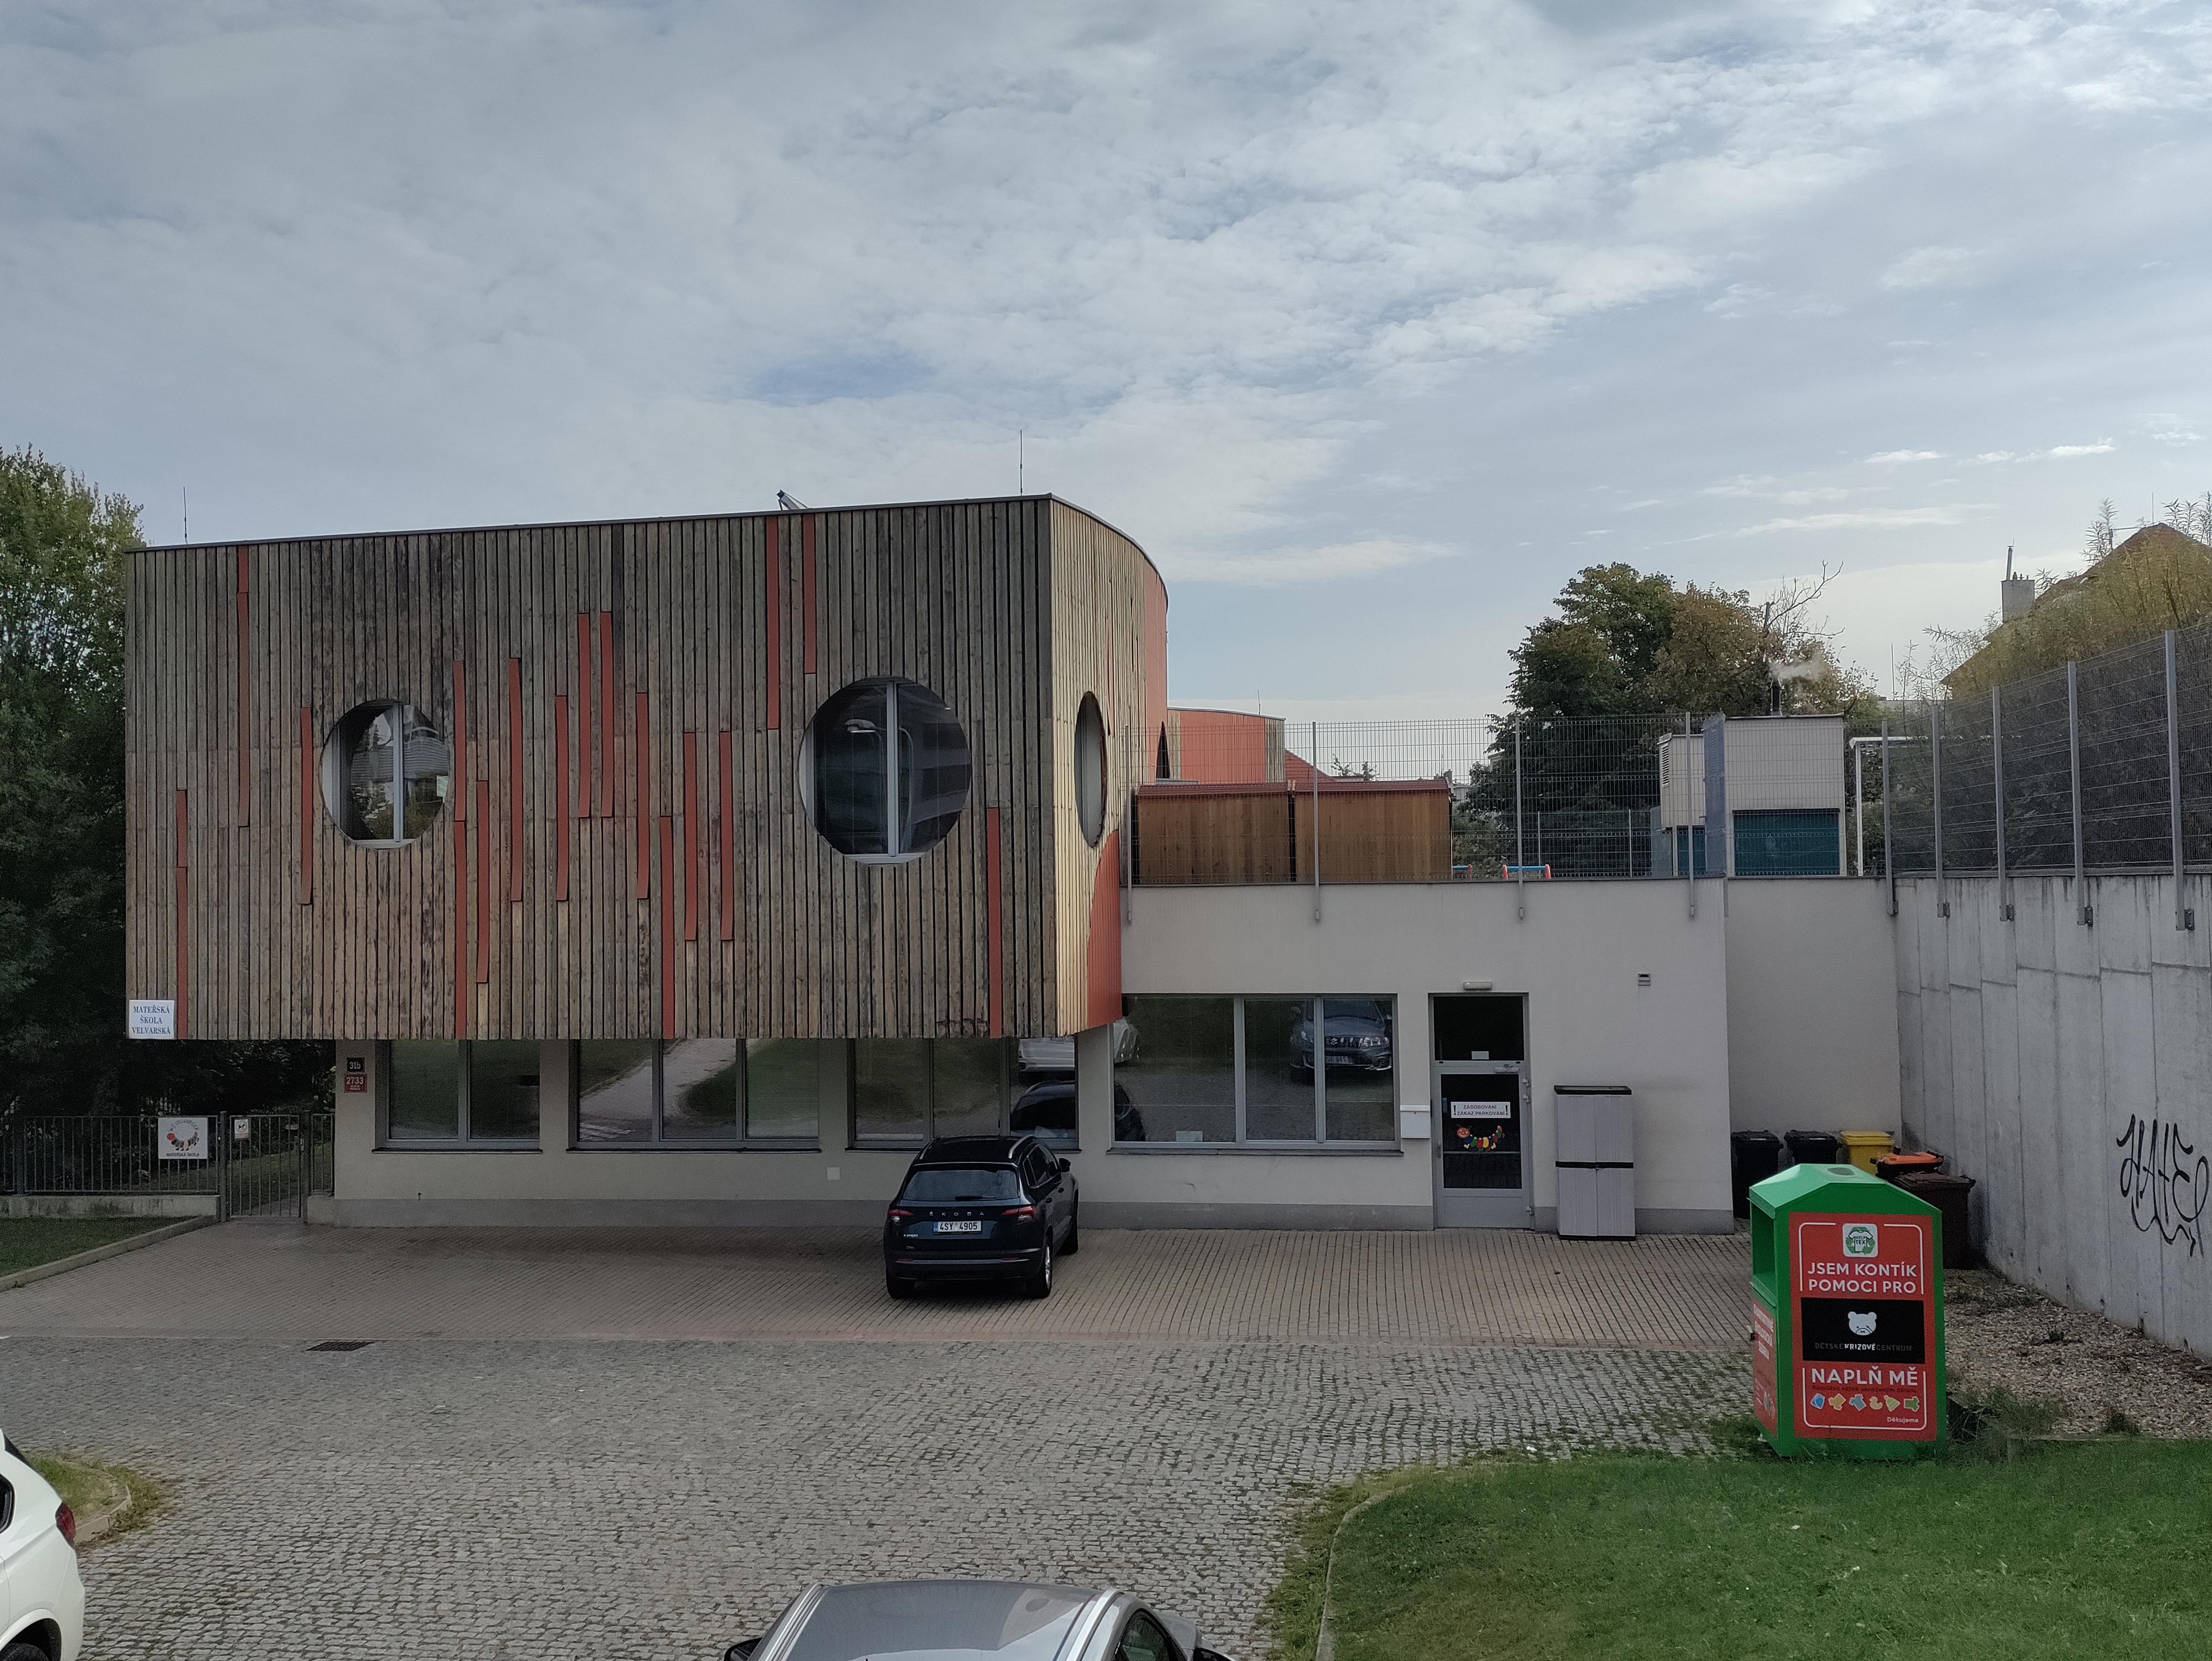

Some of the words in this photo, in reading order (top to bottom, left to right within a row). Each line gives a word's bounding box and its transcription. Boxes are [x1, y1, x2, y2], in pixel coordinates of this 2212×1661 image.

[133, 1004, 169, 1013] MATEŘSKÁ
[140, 1015, 162, 1024] ŠKOLA
[132, 1026, 171, 1034] VELVARSKÁ
[346, 1076, 364, 1085] 2733
[940, 1222, 953, 1231] 4SY
[959, 1222, 977, 1230] 4905
[1808, 1262, 1849, 1275] JSEM
[1855, 1261, 1917, 1277] KONTÍK
[1809, 1279, 1877, 1293] POMOCI
[1883, 1281, 1916, 1293] PRO
[1812, 1365, 1882, 1385] NAPLŇ
[1889, 1366, 1918, 1386] MĚ
